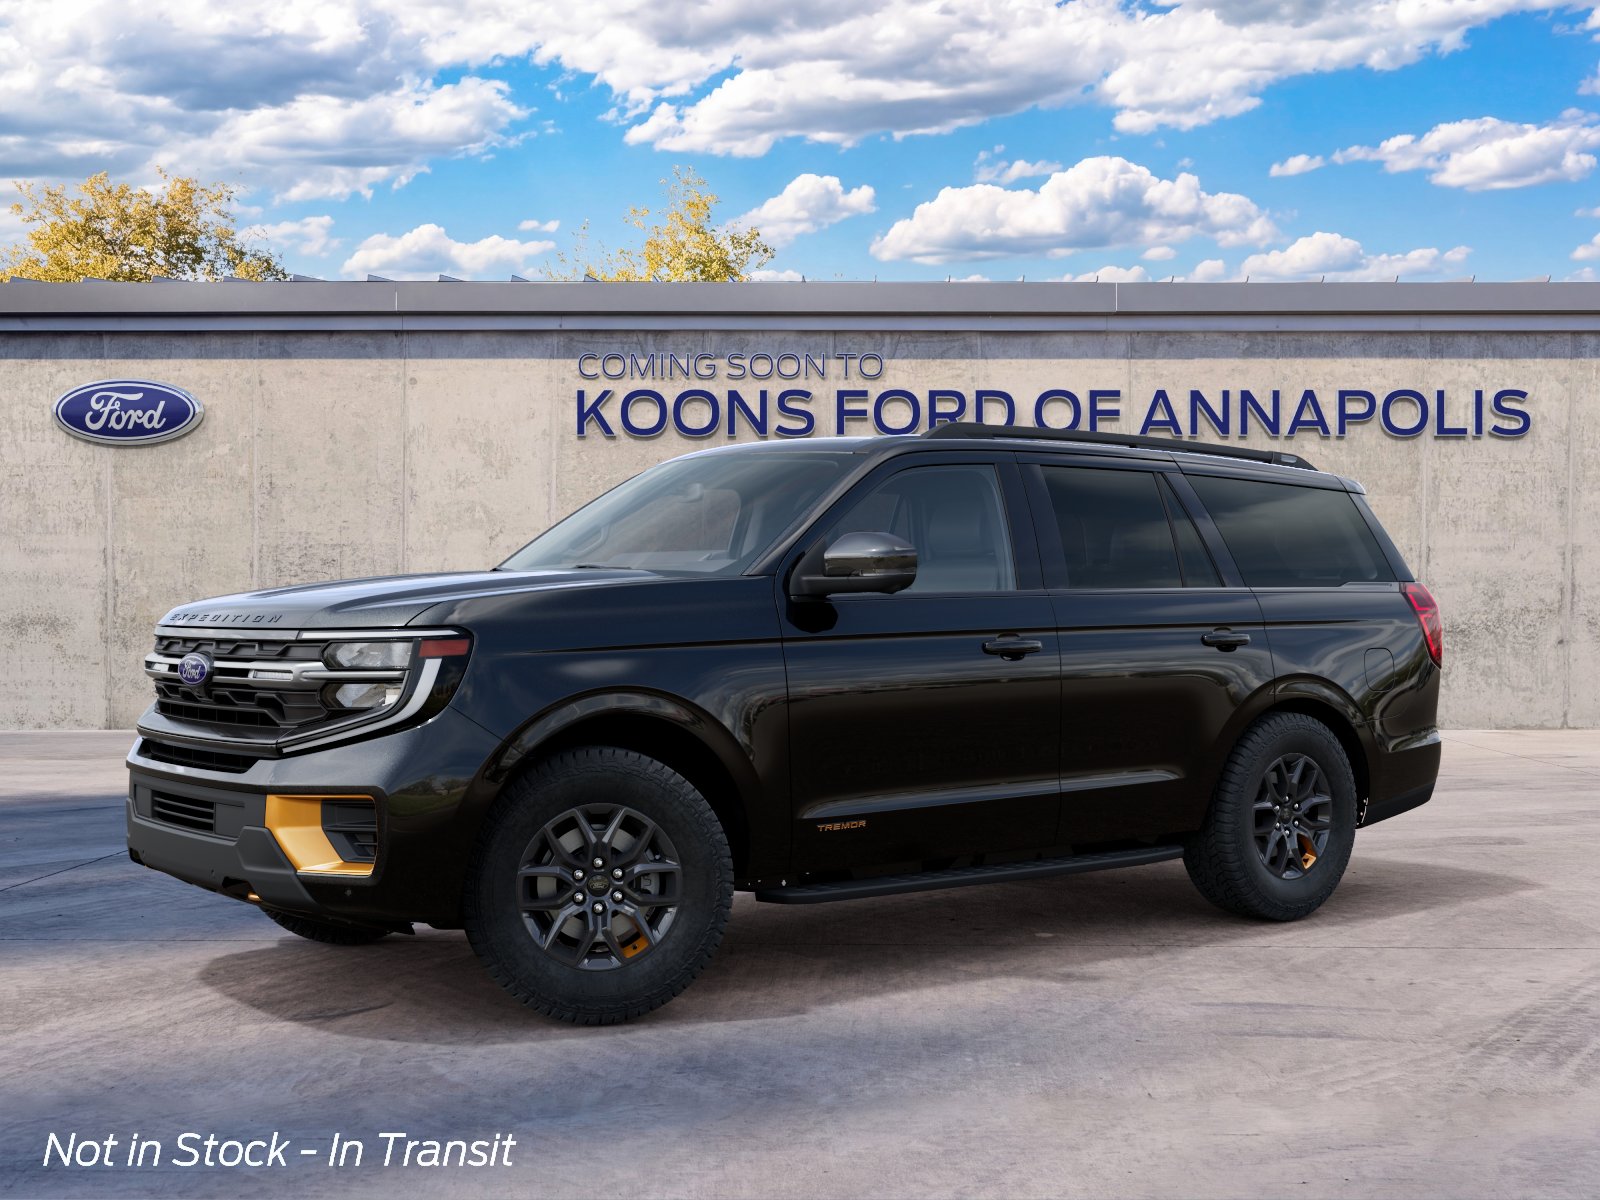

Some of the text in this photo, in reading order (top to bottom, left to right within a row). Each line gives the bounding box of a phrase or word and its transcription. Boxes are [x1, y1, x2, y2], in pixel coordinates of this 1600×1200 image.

[578, 352, 885, 379] COMING SOON TO
[85, 391, 167, 431] Ford
[576, 389, 1531, 437] KOONS FORD OF ANNAPOLIS
[169, 613, 284, 624] EXPEDITION
[183, 660, 202, 680] Ford
[817, 820, 867, 832] TREMOR
